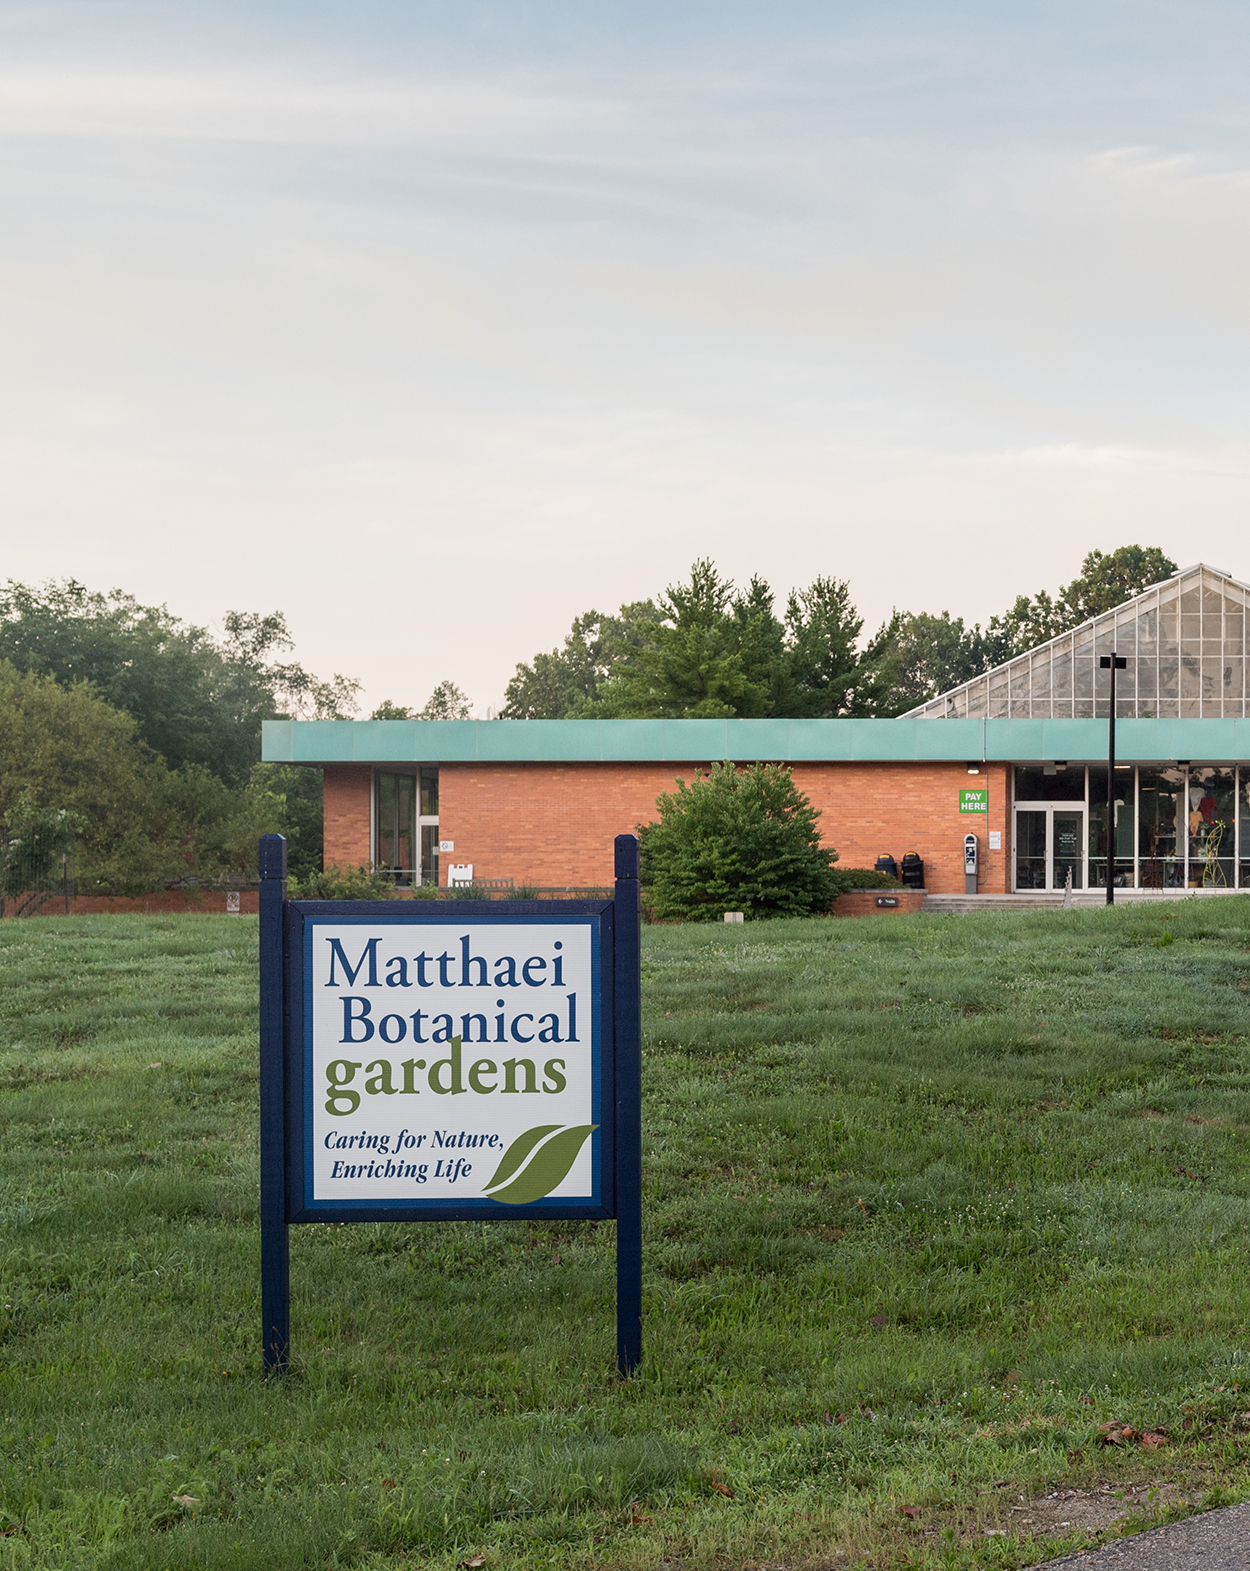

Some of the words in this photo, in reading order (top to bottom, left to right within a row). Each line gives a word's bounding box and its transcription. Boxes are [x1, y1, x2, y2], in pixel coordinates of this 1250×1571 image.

[961, 802, 987, 810] HERE
[965, 792, 982, 801] PAY
[324, 934, 567, 987] Matthaei
[338, 992, 581, 1043] Botanical
[324, 1034, 567, 1116] gardens
[324, 1130, 391, 1155] Caring
[391, 1129, 427, 1155] for
[430, 1130, 504, 1151] Nature,
[330, 1158, 429, 1184] Enriching
[433, 1158, 473, 1184] Life
